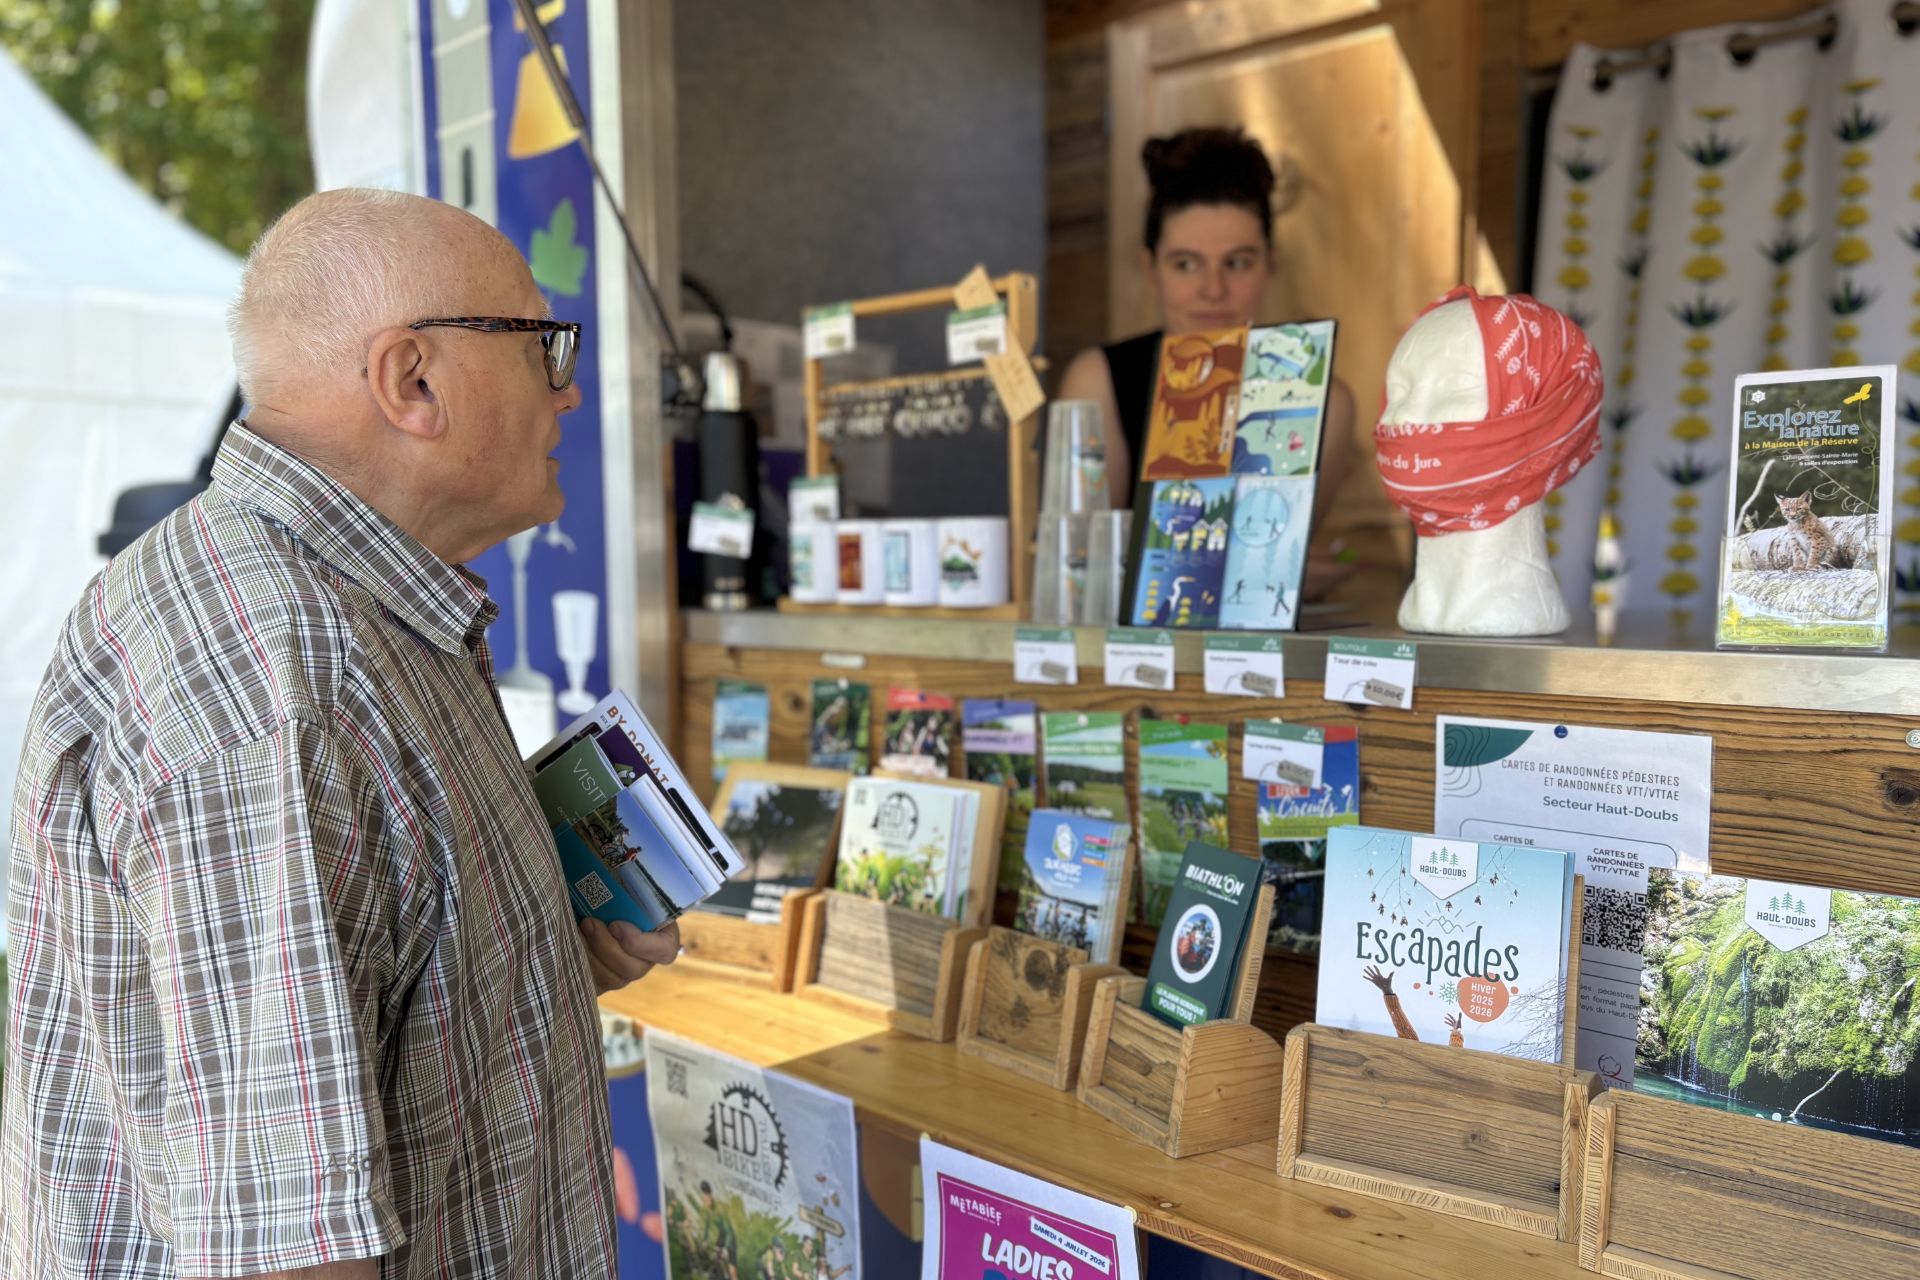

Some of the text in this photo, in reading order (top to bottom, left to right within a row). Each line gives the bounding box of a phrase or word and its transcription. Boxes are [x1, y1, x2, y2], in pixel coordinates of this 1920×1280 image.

[1743, 408, 1841, 431] Explorez
[1780, 423, 1859, 439] la nature
[1752, 441, 1760, 449] la
[1762, 440, 1795, 449] Maison
[1821, 437, 1858, 446] Réserve
[1392, 454, 1409, 470] du
[607, 705, 627, 724] BY
[573, 758, 608, 803] VISIT
[1501, 759, 1680, 787] CARTES DE RANDONNÉES PÉDESTRES
[1544, 777, 1680, 801] ET RANDONNÉES VTT/VTTAE
[1543, 796, 1679, 822] Secteur Haut-Doubs
[1494, 834, 1535, 845] CARTES DE
[1587, 855, 1645, 870] RANDONNÉES
[1593, 848, 1639, 860] CARTES DE
[1591, 865, 1640, 878] VTT/VTTAE
[1356, 921, 1519, 985] Escapades
[1471, 994, 1494, 1006] 2025
[1593, 994, 1618, 1006] format
[1596, 1006, 1606, 1014] du
[719, 1102, 758, 1157] HD
[723, 1149, 763, 1182] BIKE
[1033, 1223, 1057, 1240] SAMEDI
[1064, 1240, 1088, 1258] JUILLET
[981, 1232, 1074, 1280] LADIES
